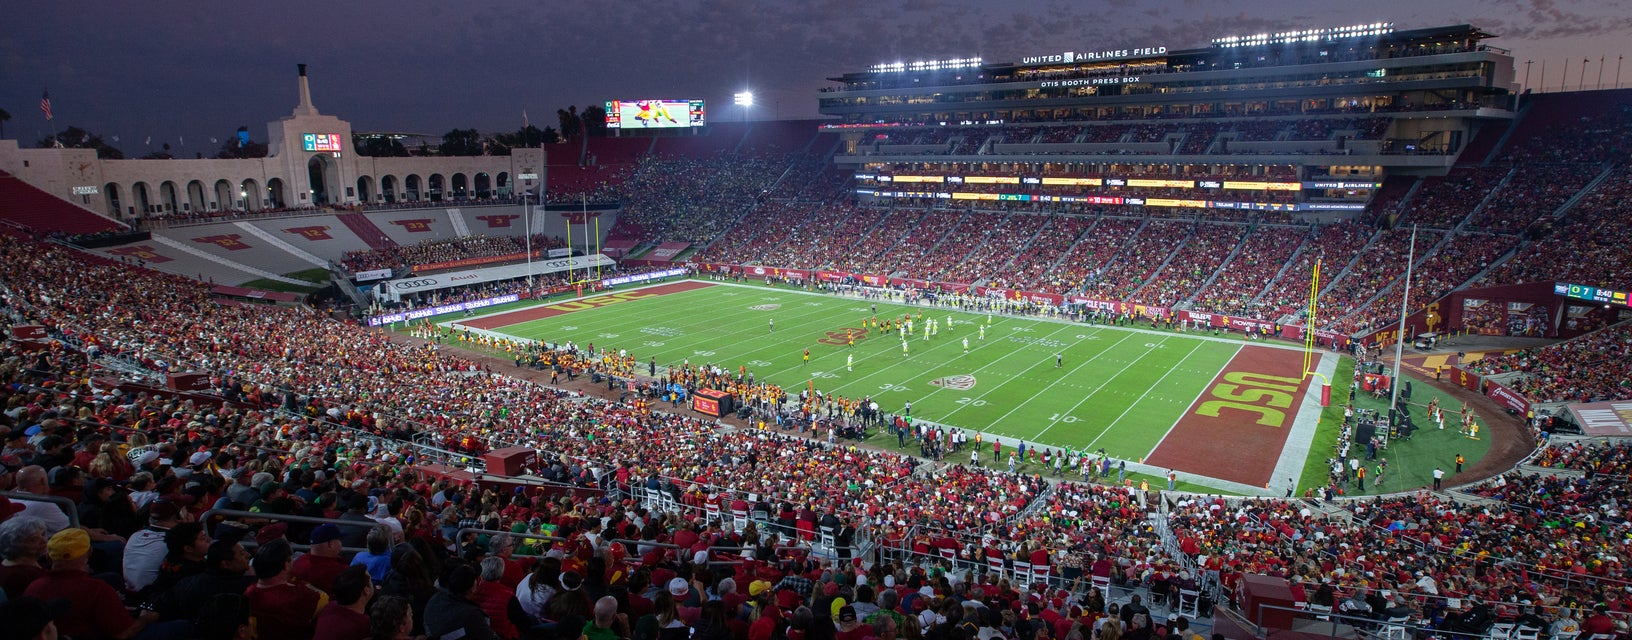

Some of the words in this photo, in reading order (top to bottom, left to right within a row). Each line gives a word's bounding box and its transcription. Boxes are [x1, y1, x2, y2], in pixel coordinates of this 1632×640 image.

[1023, 54, 1062, 64] UNITED
[1076, 50, 1128, 60] AIRLINES
[1134, 46, 1166, 56] FIELD
[1596, 289, 1612, 297] 8:40
[465, 300, 490, 309] StubHub
[492, 296, 516, 304] StubHub
[545, 292, 658, 311] USC
[436, 305, 462, 314] StubHub
[372, 315, 401, 325] StbHub
[1233, 320, 1271, 329] POWERDE
[1376, 332, 1389, 342] WE
[878, 383, 905, 392] 30
[955, 397, 988, 407] 20
[1195, 371, 1304, 428] USC
[1048, 413, 1078, 423] 10
